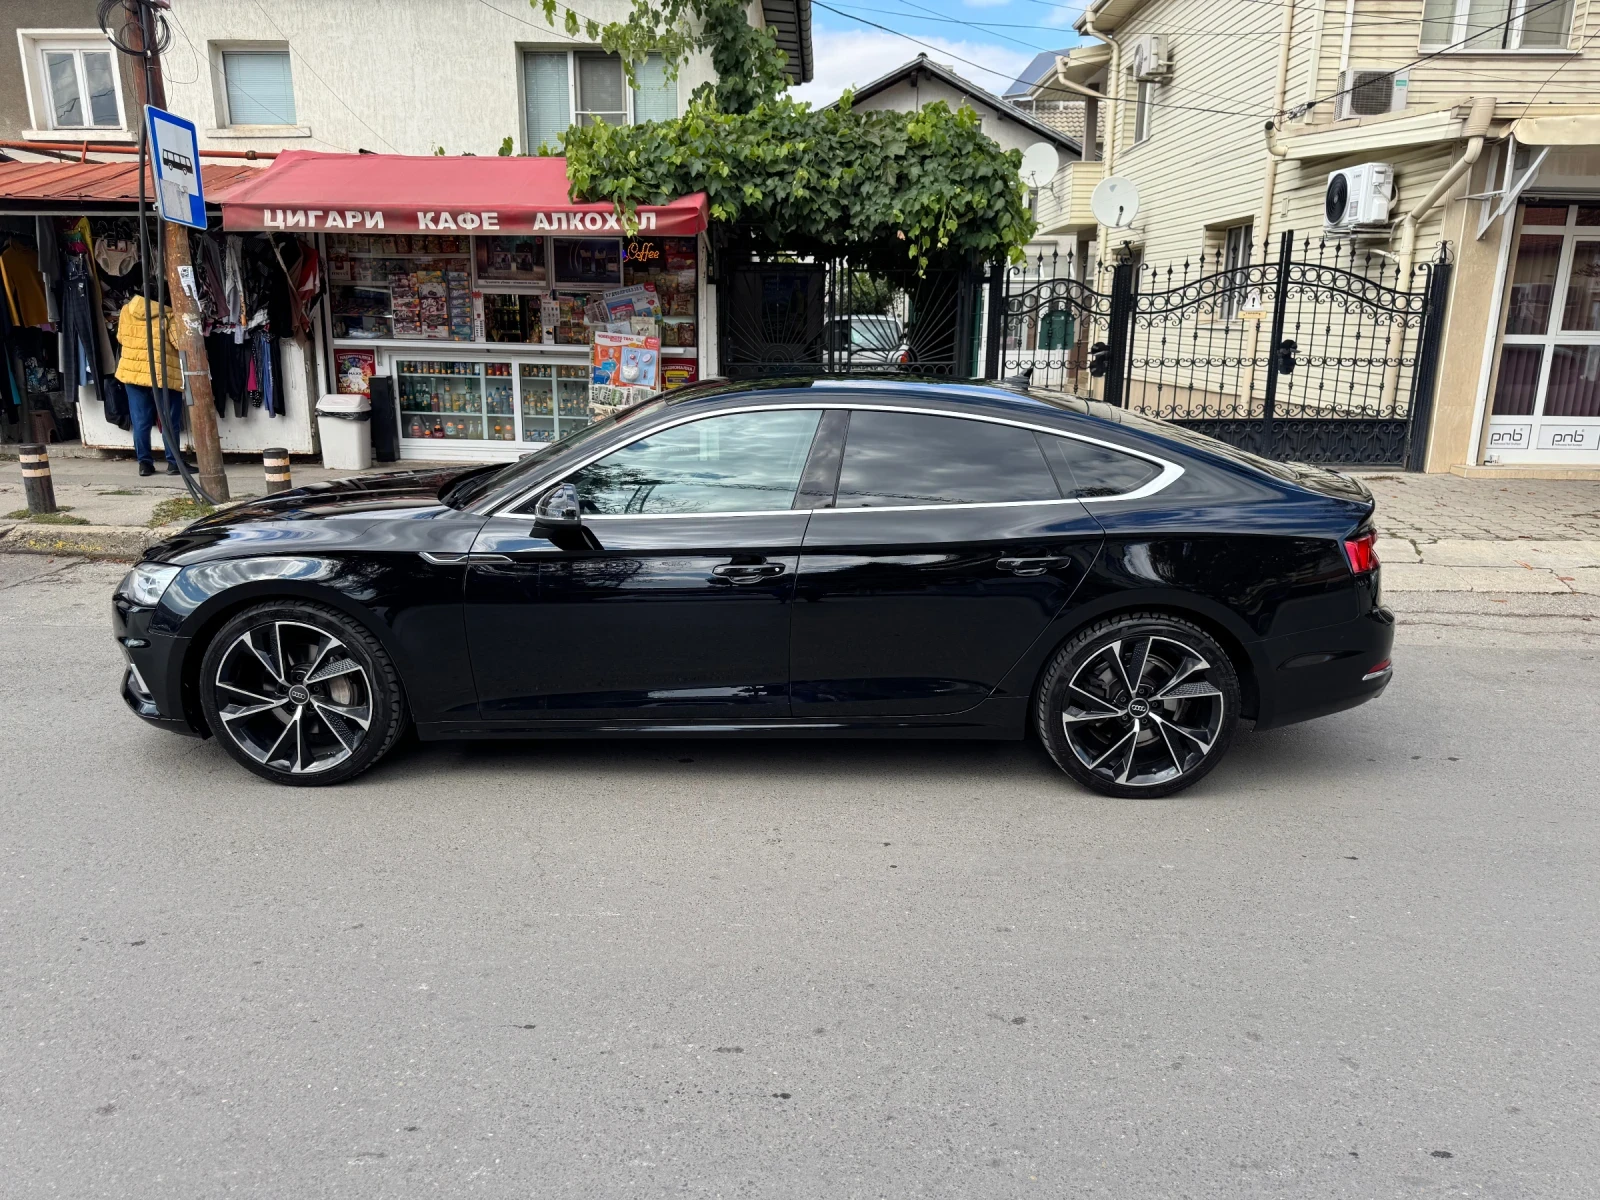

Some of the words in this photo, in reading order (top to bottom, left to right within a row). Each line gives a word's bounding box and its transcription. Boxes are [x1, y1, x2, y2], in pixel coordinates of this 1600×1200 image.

[263, 208, 385, 230] ЦИГАРИ
[416, 211, 500, 230] КАФЕ
[627, 242, 660, 262] Coffee
[1490, 428, 1523, 445] pnb
[1551, 430, 1584, 446] pnb
